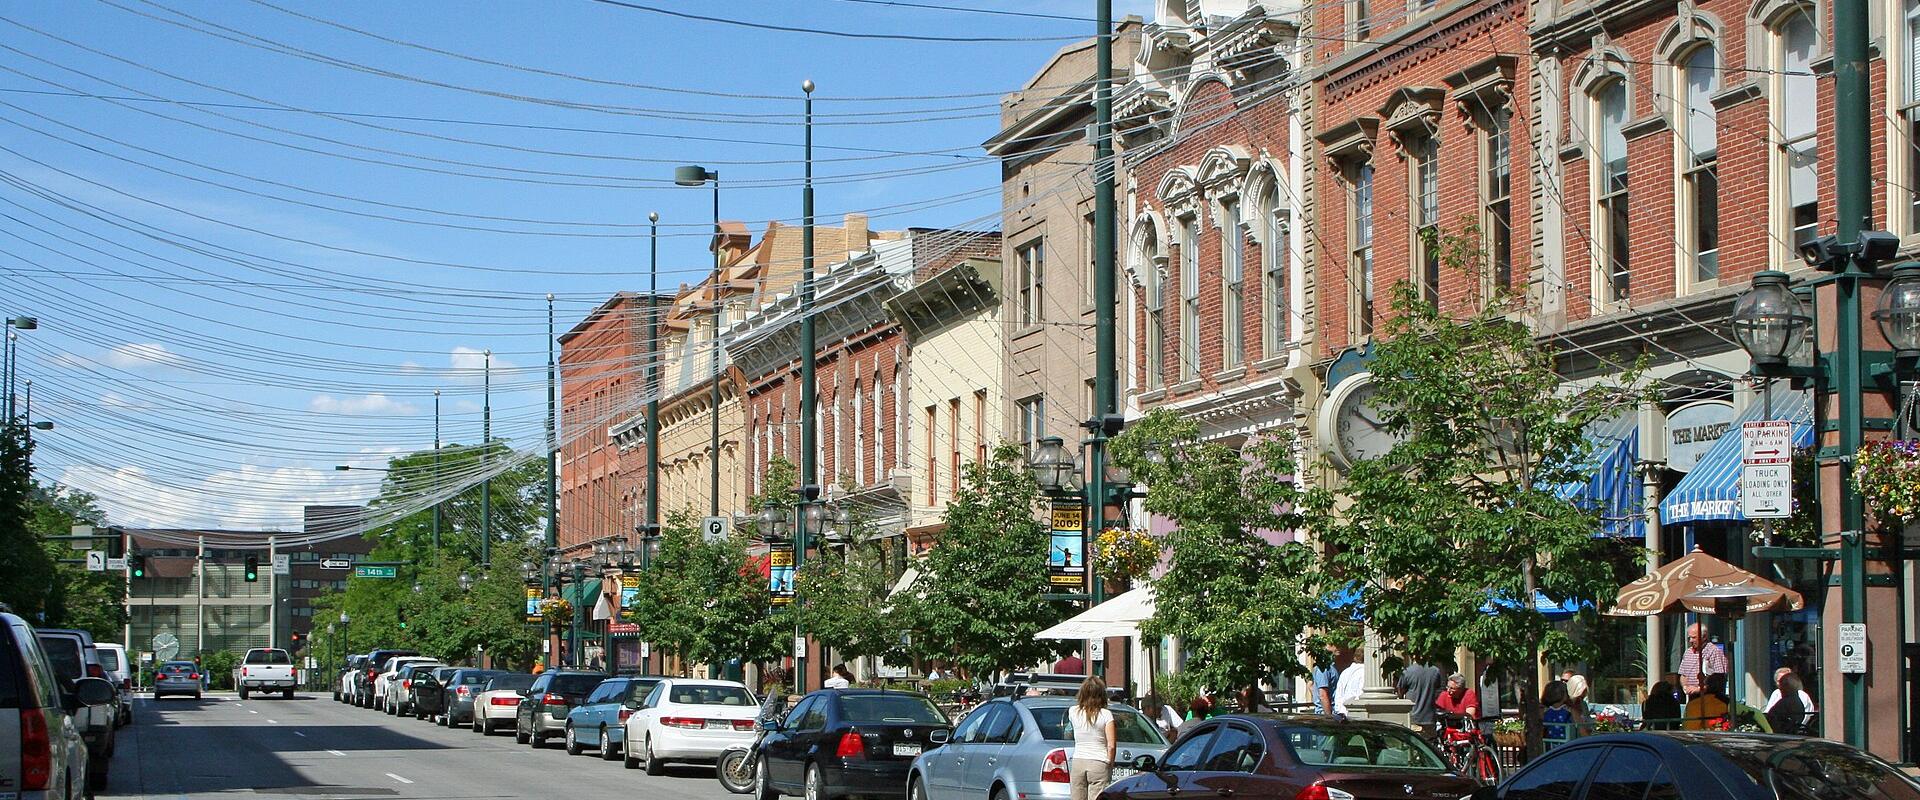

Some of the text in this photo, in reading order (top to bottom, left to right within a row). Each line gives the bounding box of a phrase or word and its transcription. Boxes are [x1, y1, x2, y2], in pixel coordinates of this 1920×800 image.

[1672, 427, 1692, 445] THE
[1744, 429, 1788, 439] NO PARKING
[1754, 469, 1779, 478] TRUCK
[1745, 479, 1788, 489] LOADING ONLY
[1752, 490, 1762, 498] ALL
[1669, 500, 1735, 519] THE MARKET
[1053, 519, 1081, 528] 2009
[367, 568, 384, 577] 14th
